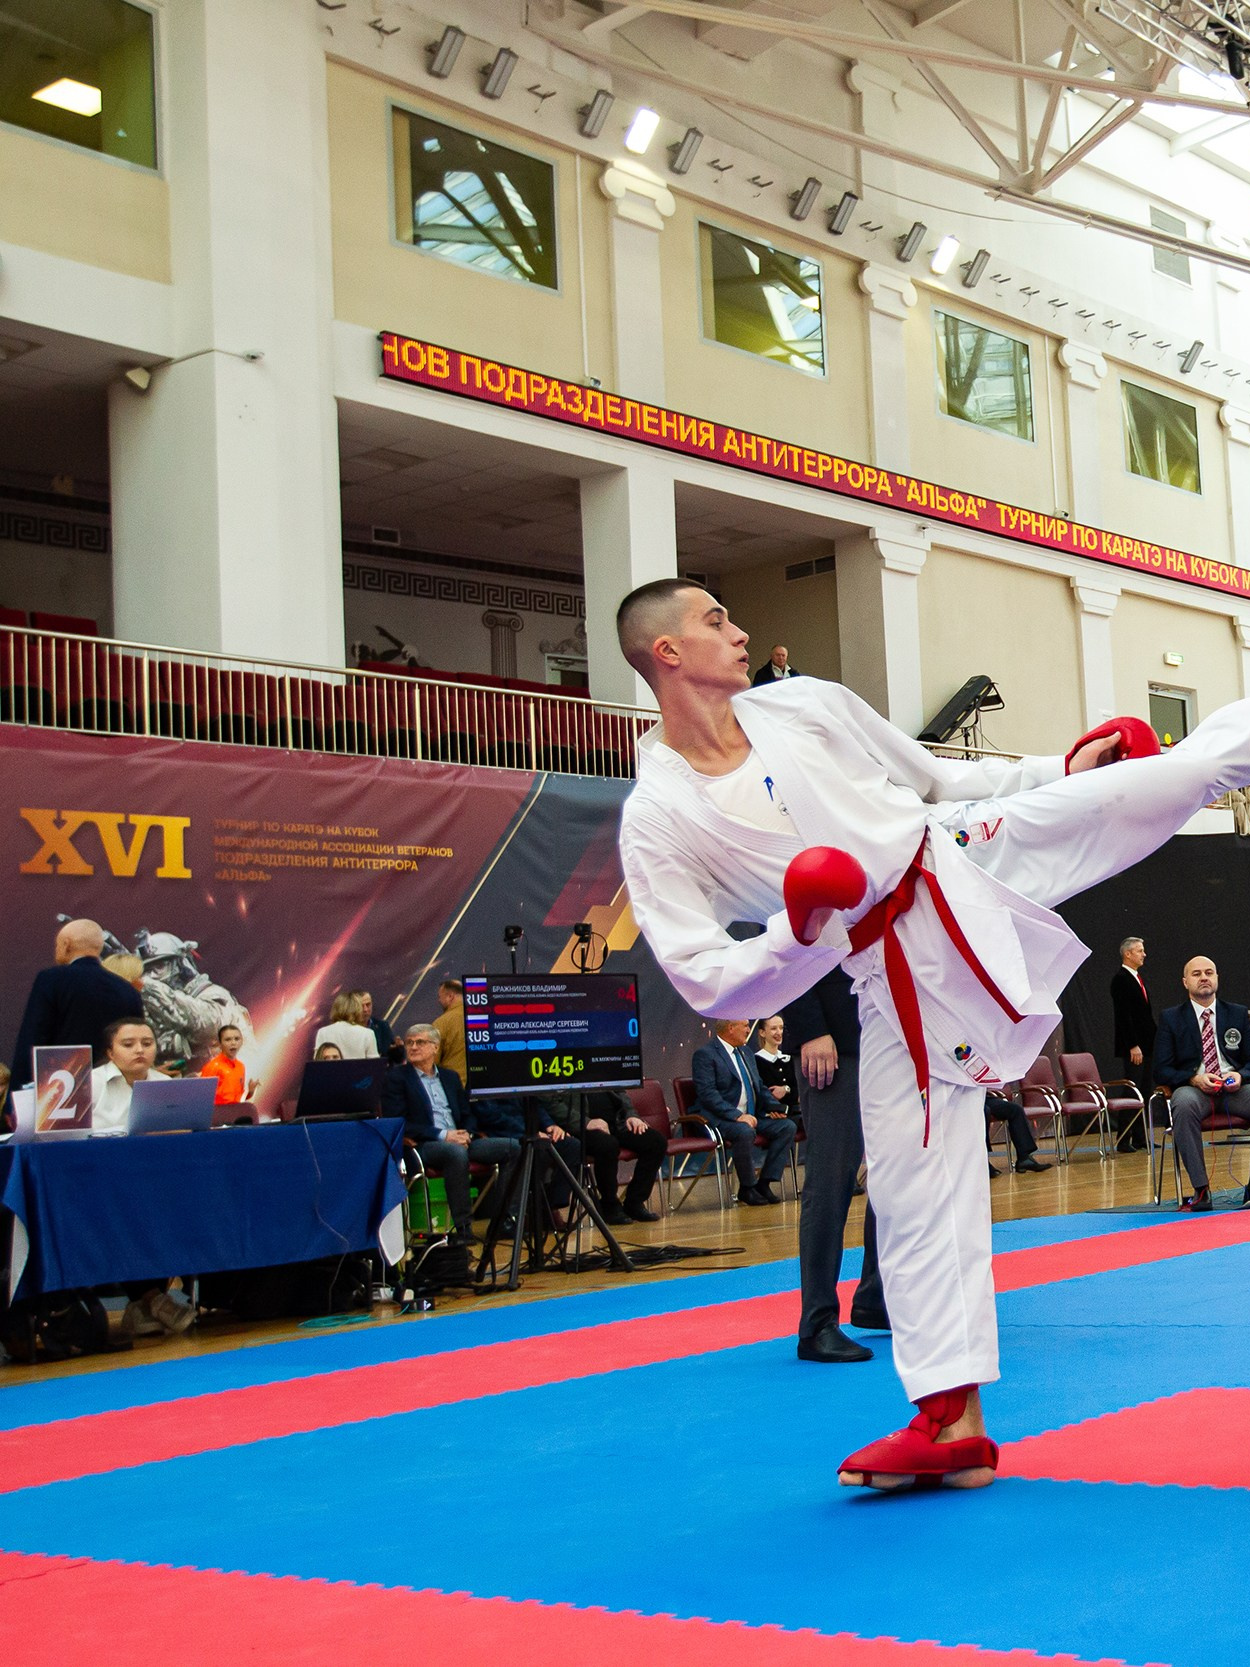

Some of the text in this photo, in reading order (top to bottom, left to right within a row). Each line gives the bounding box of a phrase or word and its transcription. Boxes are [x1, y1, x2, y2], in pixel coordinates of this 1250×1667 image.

[460, 354, 715, 450] ПОДРАЗДЕЛЕНИЯ
[723, 429, 893, 497] АНТИТЕРРОРА
[897, 475, 987, 520] "АЛЬФА"
[996, 503, 1068, 542] ТУРНИР
[1072, 524, 1098, 550] ПО
[1102, 532, 1162, 567] КАРАТЭ
[1166, 550, 1187, 575] НА
[1190, 558, 1240, 588] КУБОК
[263, 821, 279, 832] ПО
[283, 822, 324, 835] КАРАТЭ
[327, 825, 342, 836] НА
[344, 827, 379, 838] КУБОК
[19, 807, 193, 879] XVI
[322, 842, 394, 856] АССОЦИАЦИИ
[397, 845, 453, 858] ВЕТЕРАНОВ
[215, 852, 418, 871] ПОДРАЗДЕЛЕНИЯ АНТИТЕРРОРА
[492, 985, 531, 993] БРАЖНИКОВ
[466, 993, 488, 1006] RUS
[494, 1022, 519, 1030] МЕРКОВ
[629, 1018, 638, 1037] 0
[468, 1031, 490, 1043] RUS
[48, 1069, 77, 1120] 2
